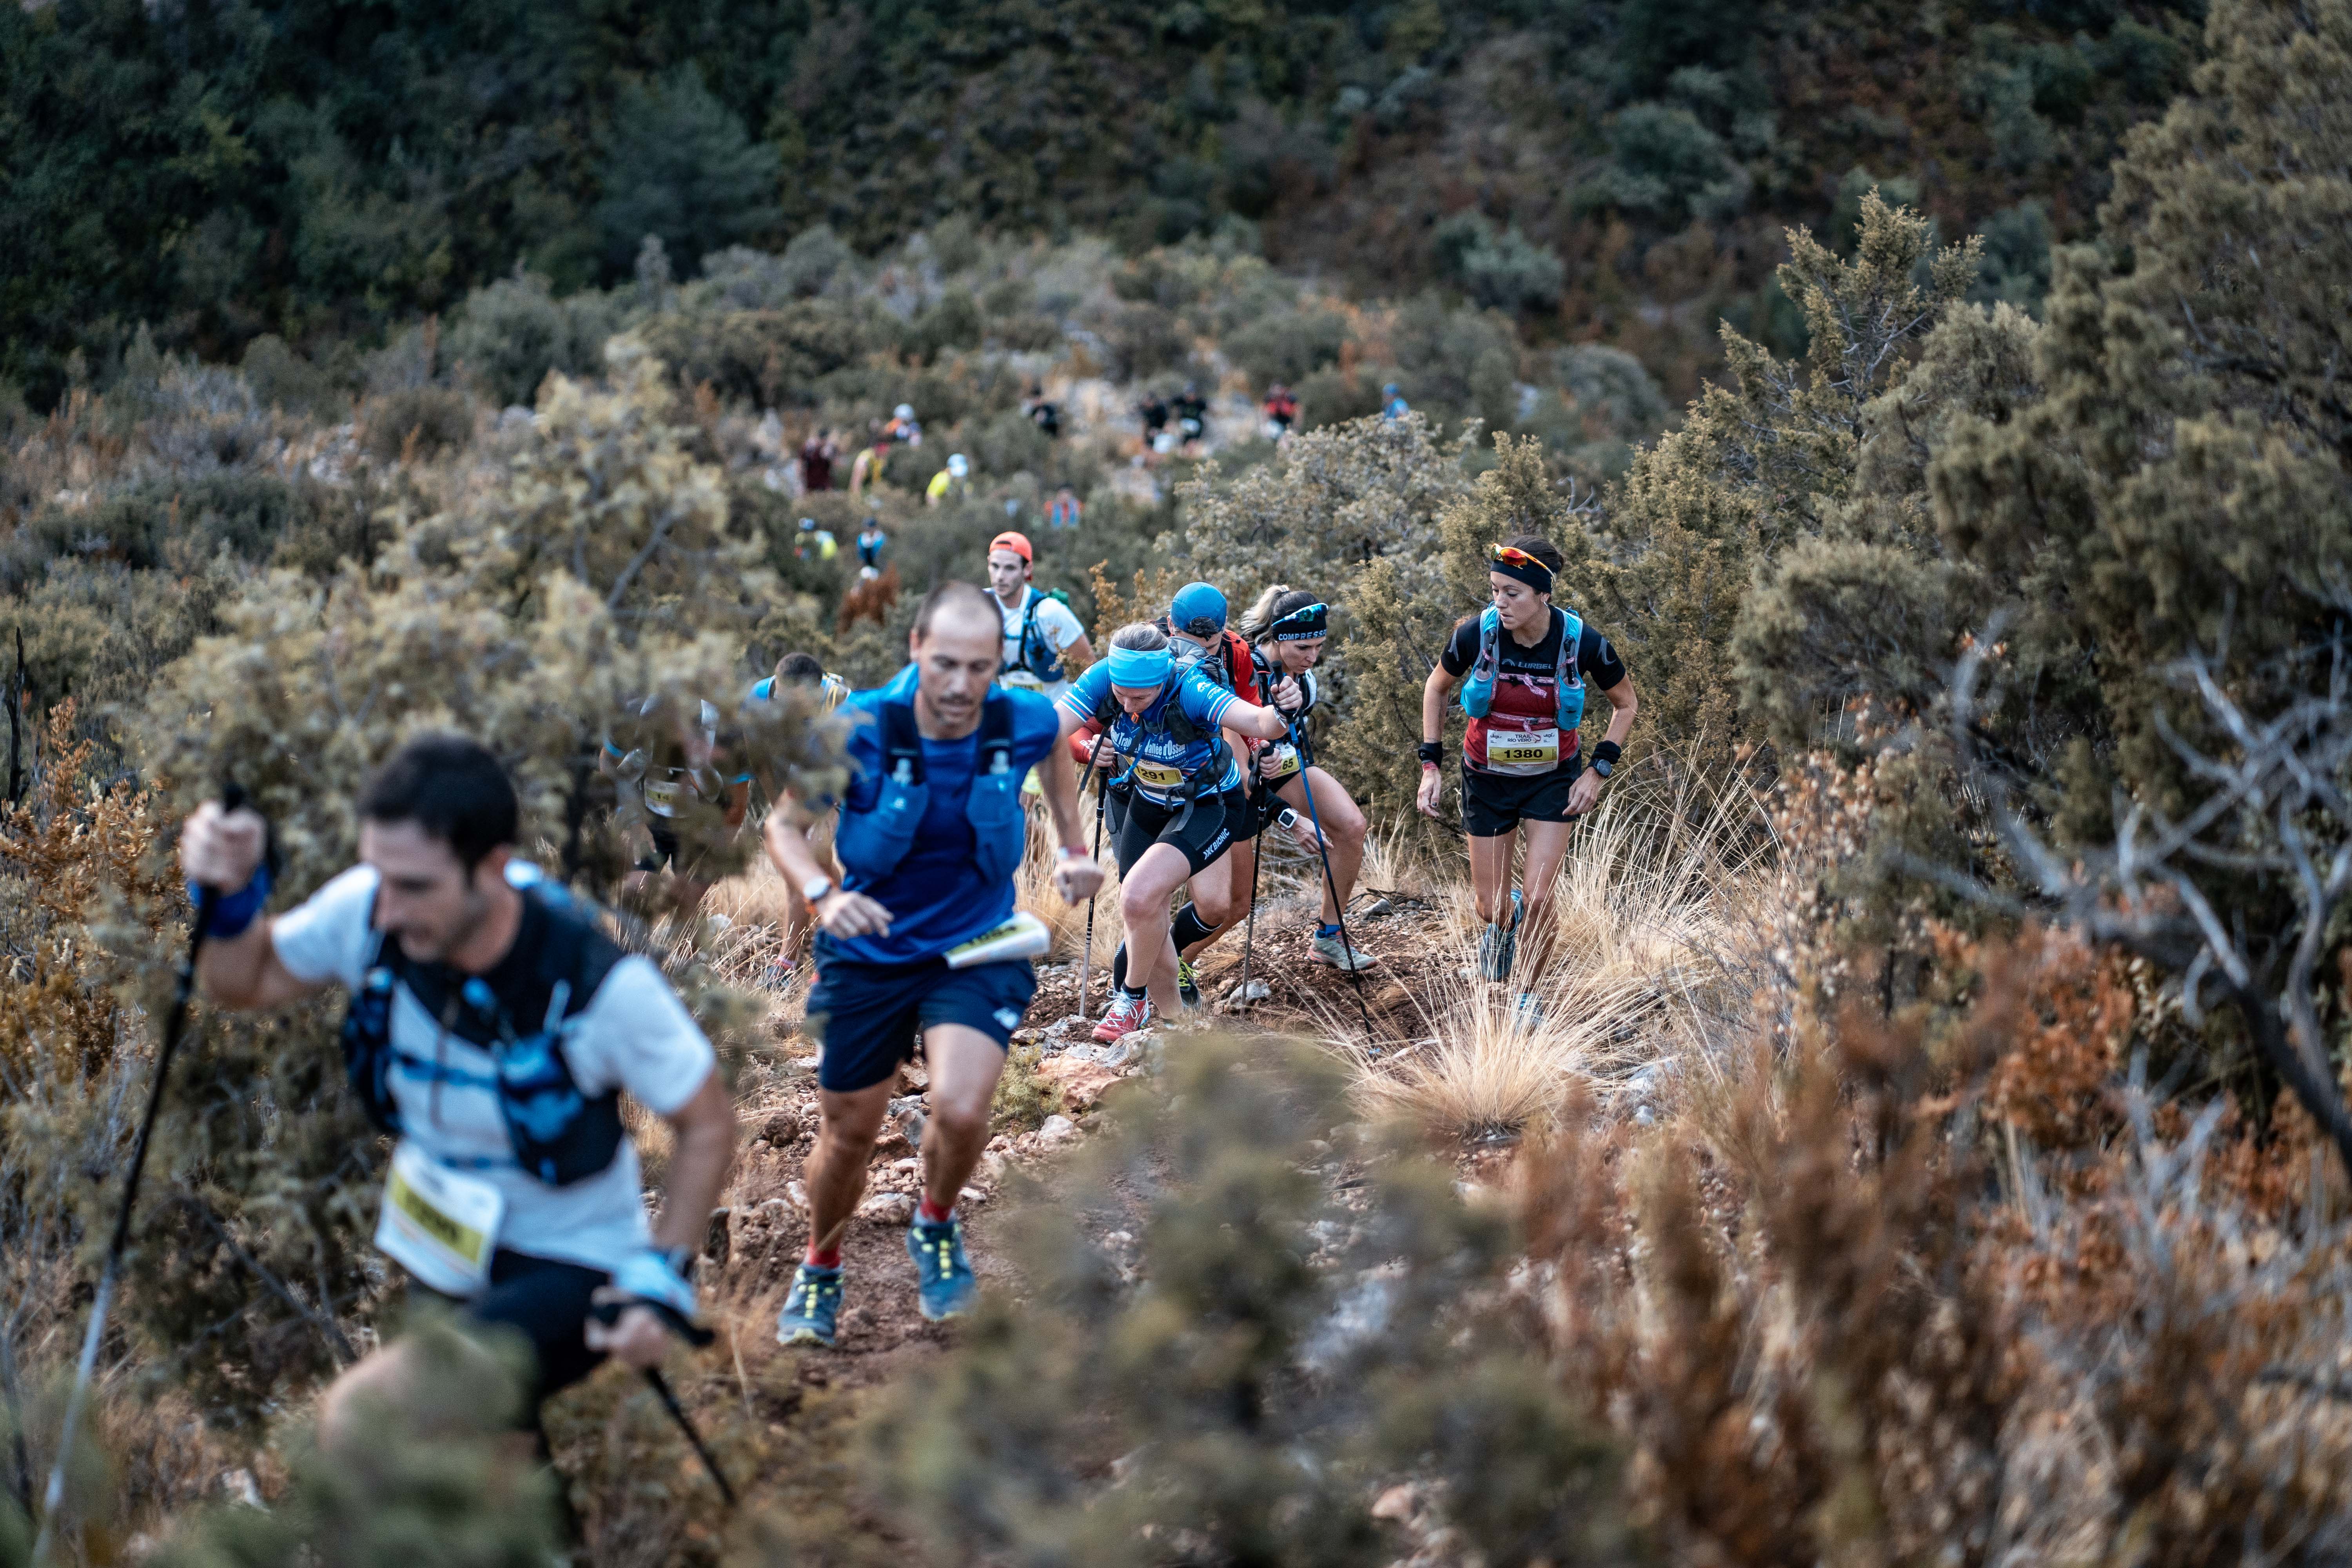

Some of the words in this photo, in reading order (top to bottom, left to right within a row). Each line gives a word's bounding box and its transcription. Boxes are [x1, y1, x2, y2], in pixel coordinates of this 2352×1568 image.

[1118, 732, 1132, 747] Trail
[1144, 739, 1162, 756] Vallée
[1504, 749, 1543, 759] 1380
[1136, 766, 1165, 780] 1291
